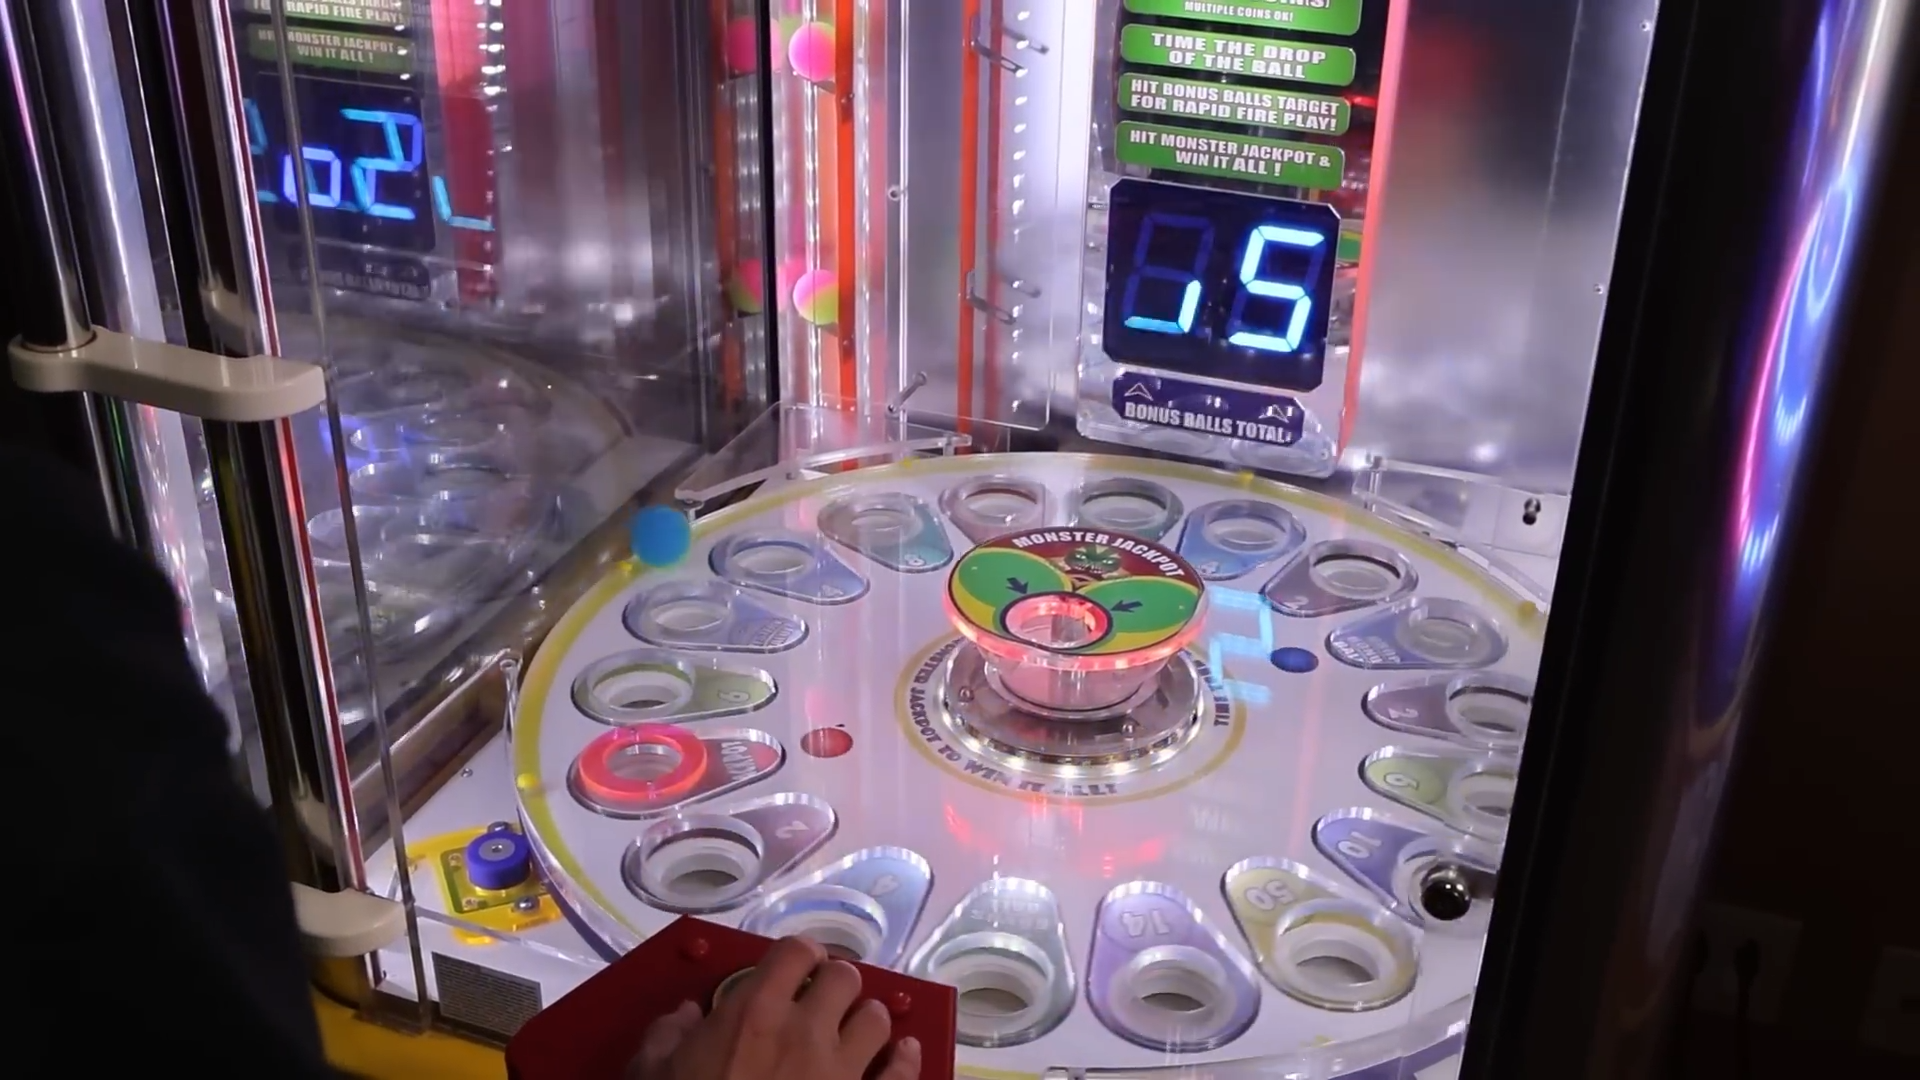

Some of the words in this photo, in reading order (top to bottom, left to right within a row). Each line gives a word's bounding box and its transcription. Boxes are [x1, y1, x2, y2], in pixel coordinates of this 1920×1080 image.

[287, 1, 329, 15] RAPID
[333, 6, 362, 19] FIRE
[1184, 1, 1235, 17] MULTIPLE
[1237, 7, 1271, 20] COINS
[1273, 10, 1294, 22] OK!
[297, 47, 323, 58] WIN
[340, 50, 365, 63] ALL
[343, 38, 394, 53] JACKPOT
[1151, 33, 1206, 51] TIME
[1213, 38, 1255, 56] THE
[1264, 45, 1326, 64] DROP
[1169, 51, 1197, 66] OF
[1203, 54, 1244, 71] THE
[1251, 60, 1306, 79] BALL
[1131, 79, 1158, 94] HIT
[1162, 82, 1219, 101] BONUS
[1223, 89, 1273, 108] BALLS
[1277, 95, 1339, 116] TARGET
[1131, 94, 1166, 110] FOR
[1172, 100, 1231, 118] RAPID
[1236, 106, 1278, 124] FIRE
[1283, 112, 1337, 131] PLAY!
[1130, 130, 1156, 144] HIT
[1160, 132, 1237, 155] MONSTER
[1241, 143, 1315, 166] JACKPOT
[1319, 155, 1331, 167] &
[1176, 151, 1209, 167] WIN
[1213, 155, 1228, 169] IT
[1232, 158, 1267, 175] ALL
[1124, 402, 1180, 427] BONUS
[1183, 411, 1233, 434] BALLS
[1236, 420, 1287, 442] TOTAL
[1012, 531, 1109, 549] MONSTER
[1111, 537, 1186, 577] JACKPOT
[909, 687, 942, 742] JACKPOT
[938, 744, 962, 762] TO
[1337, 831, 1382, 859] 10
[1245, 879, 1295, 911] 50
[1120, 908, 1171, 937] 14
